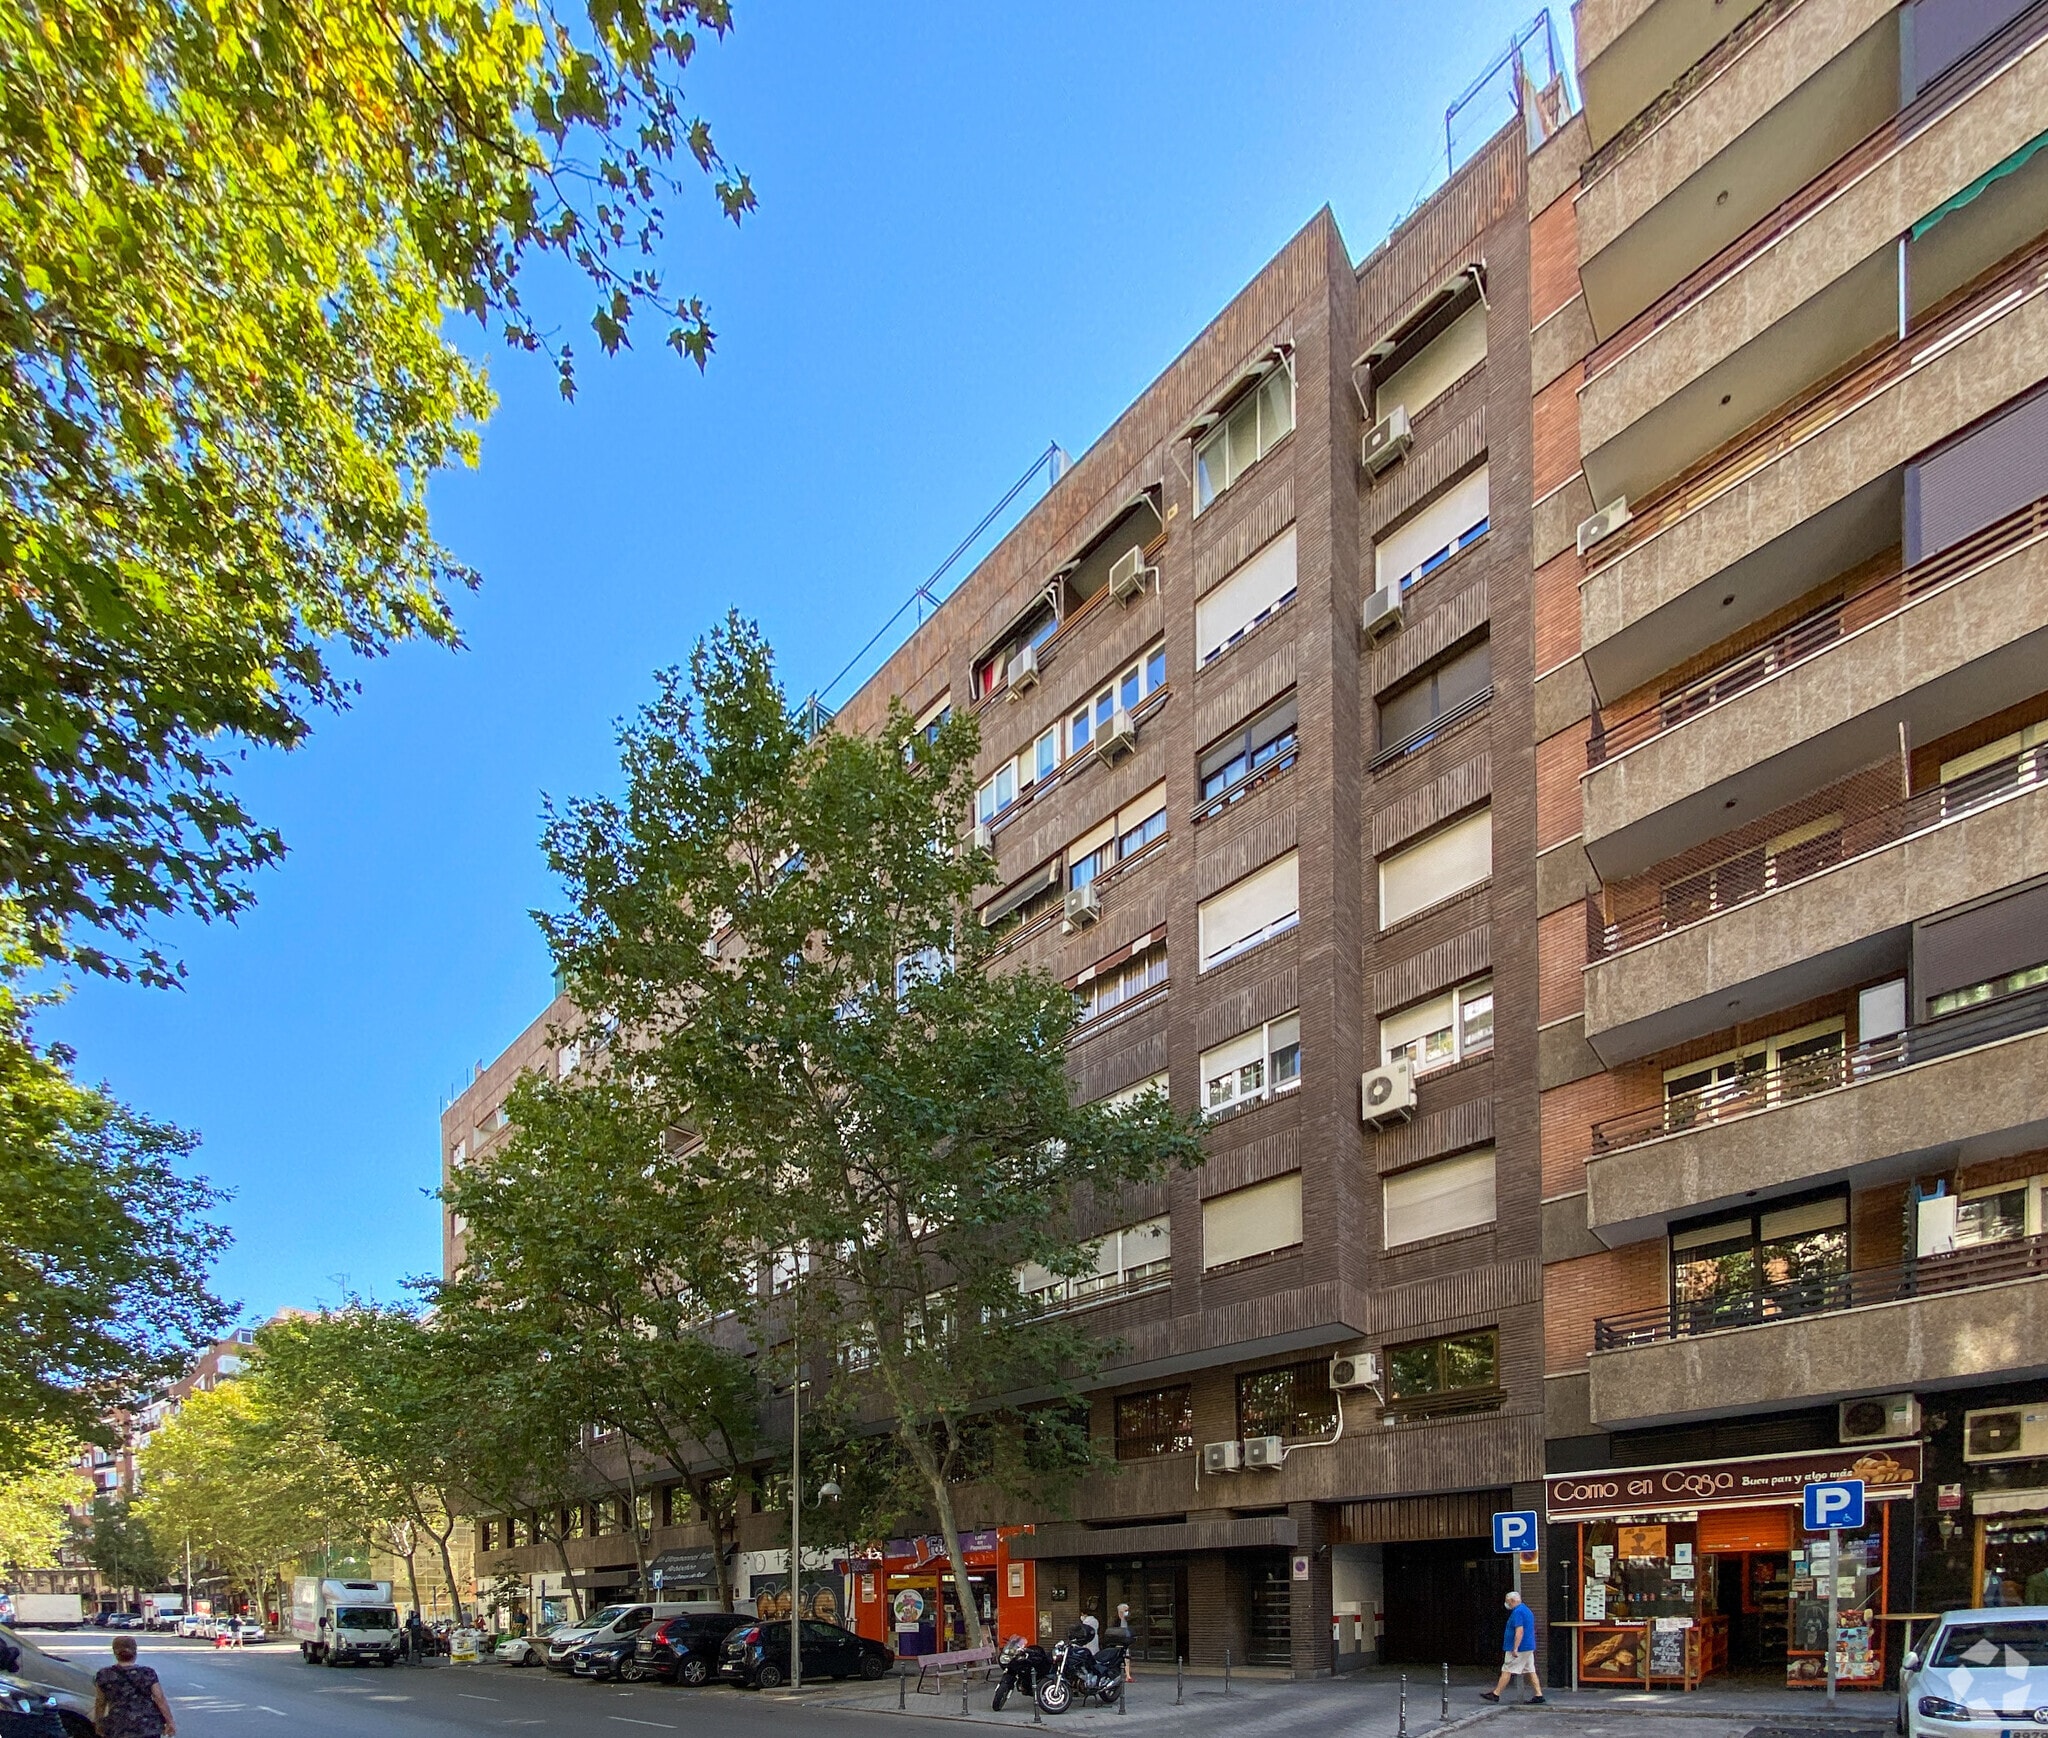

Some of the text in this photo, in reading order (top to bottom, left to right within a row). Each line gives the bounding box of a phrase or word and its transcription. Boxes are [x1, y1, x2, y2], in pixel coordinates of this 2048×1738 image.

[1554, 1470, 1734, 1501] Como en Casa
[1741, 1468, 1853, 1487] Buen pan y algo más
[1815, 1487, 1851, 1524] P
[1502, 1516, 1527, 1548] P
[654, 1572, 660, 1586] P
